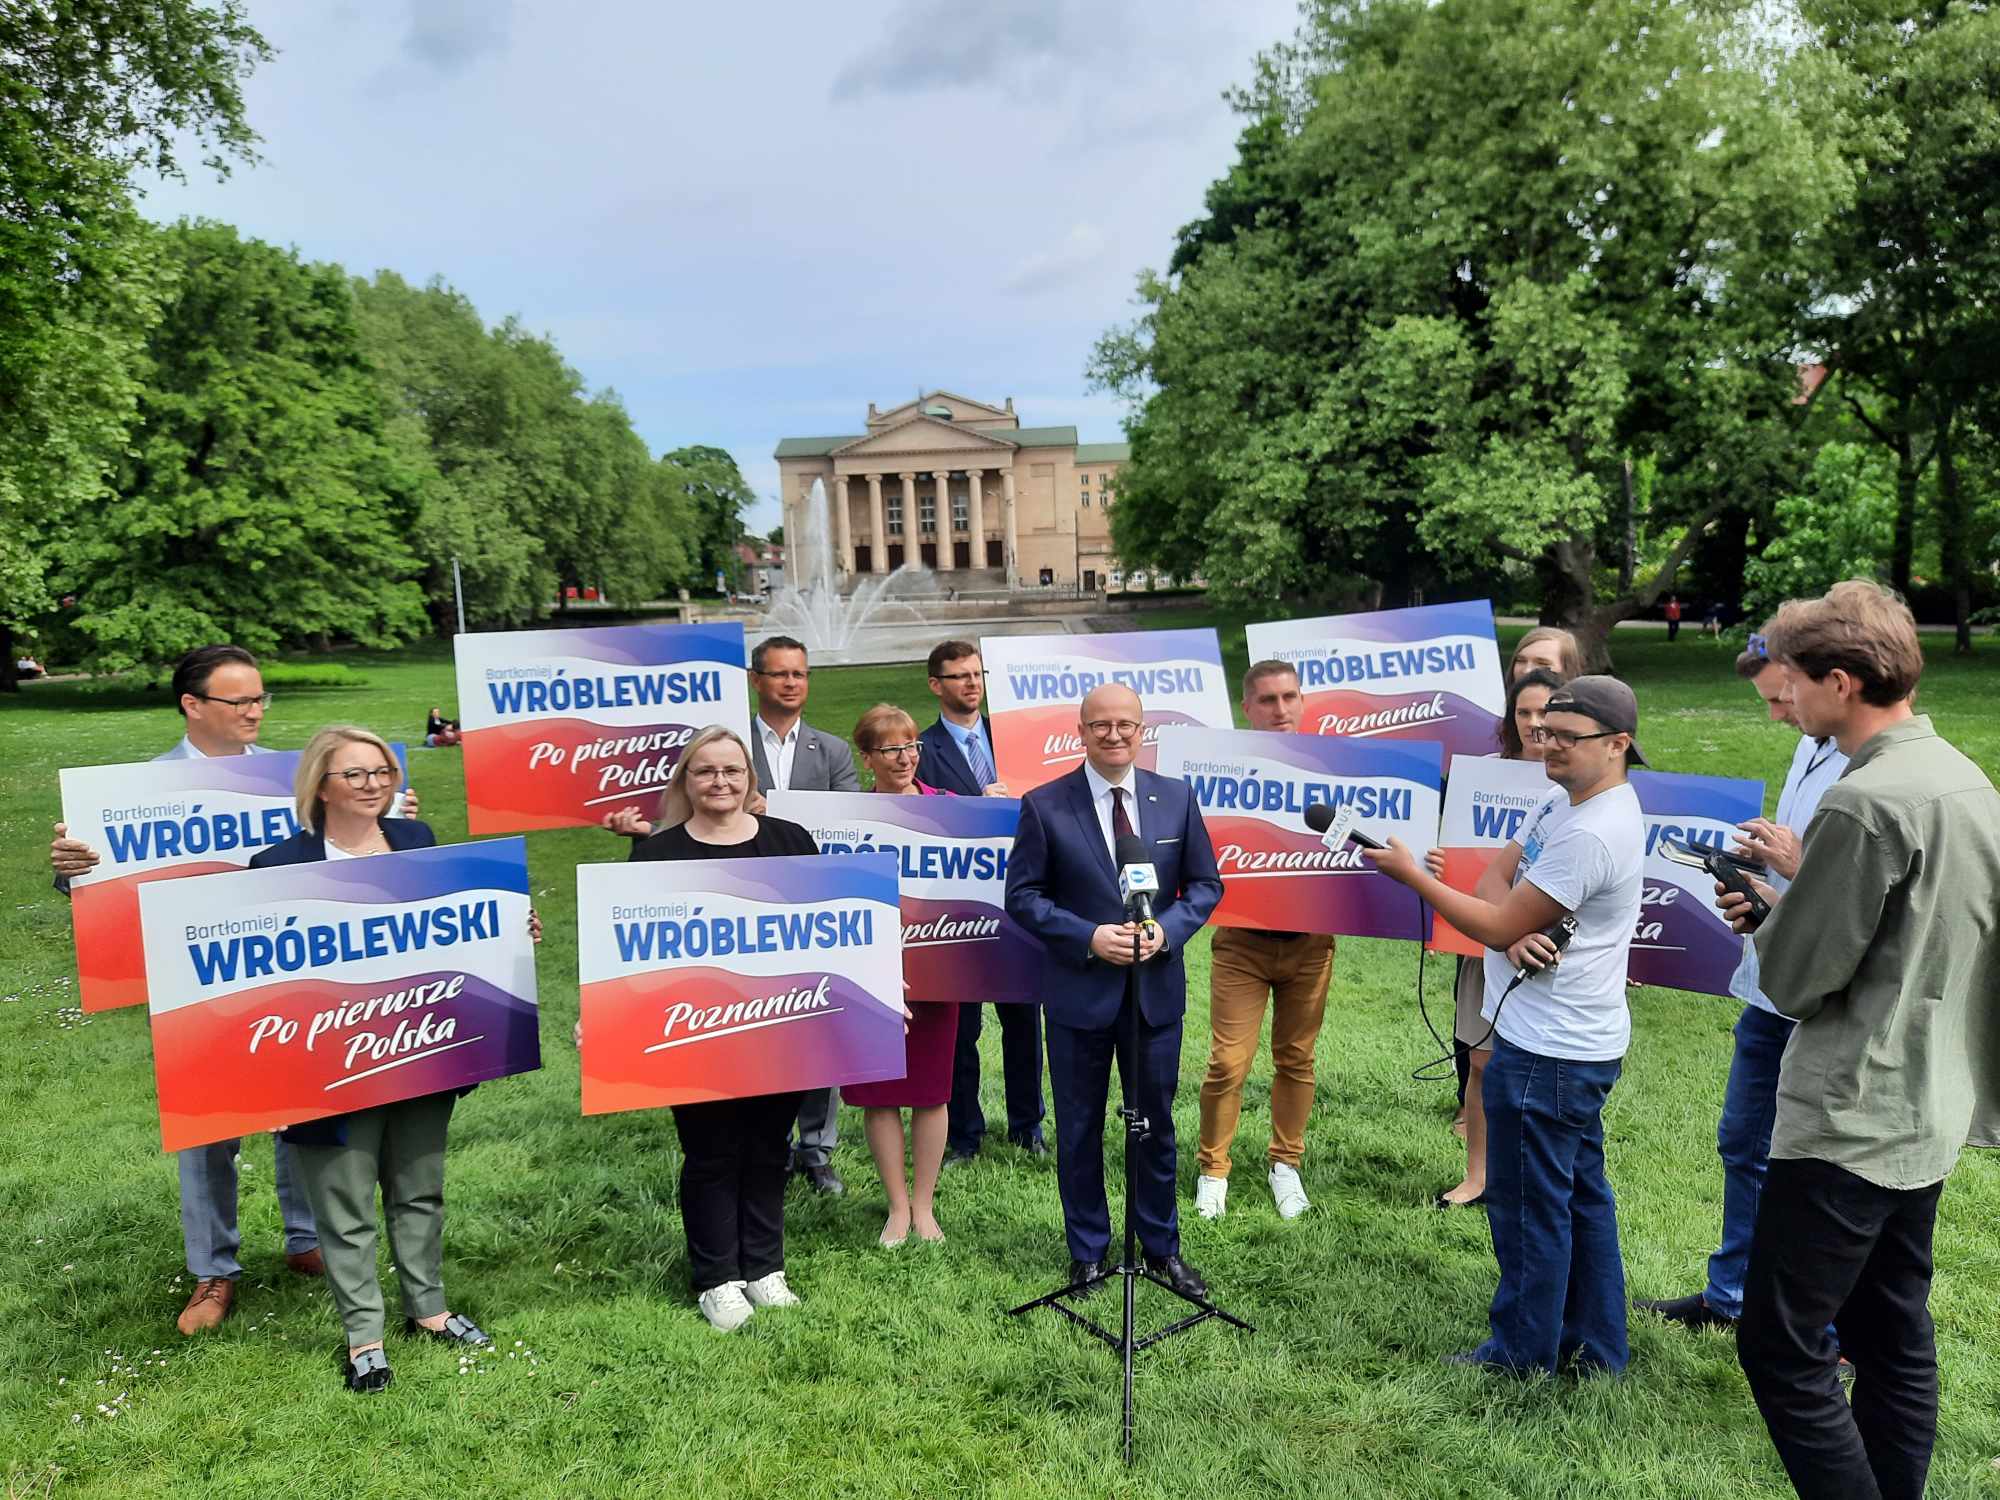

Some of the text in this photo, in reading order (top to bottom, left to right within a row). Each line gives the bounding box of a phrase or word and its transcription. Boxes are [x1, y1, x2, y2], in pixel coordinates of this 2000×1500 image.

[488, 668, 722, 714] WRÓBLEWSKI
[1317, 692, 1446, 736] Poznaniak
[529, 728, 694, 774] Po pierwsze
[1182, 760, 1246, 777] Bartłomiej
[102, 801, 186, 822] Bartłomiej
[1216, 843, 1365, 870] Poznaniak
[185, 913, 279, 941] Bartłomiej
[611, 902, 689, 921] Bartłomiej
[613, 906, 874, 963] WRÓBLEWSKI
[188, 899, 501, 986] WRÓBLEWSKI
[248, 974, 466, 1054] Po pierwsze
[663, 976, 832, 1037] Poznaniak
[343, 1015, 457, 1070] Polska
